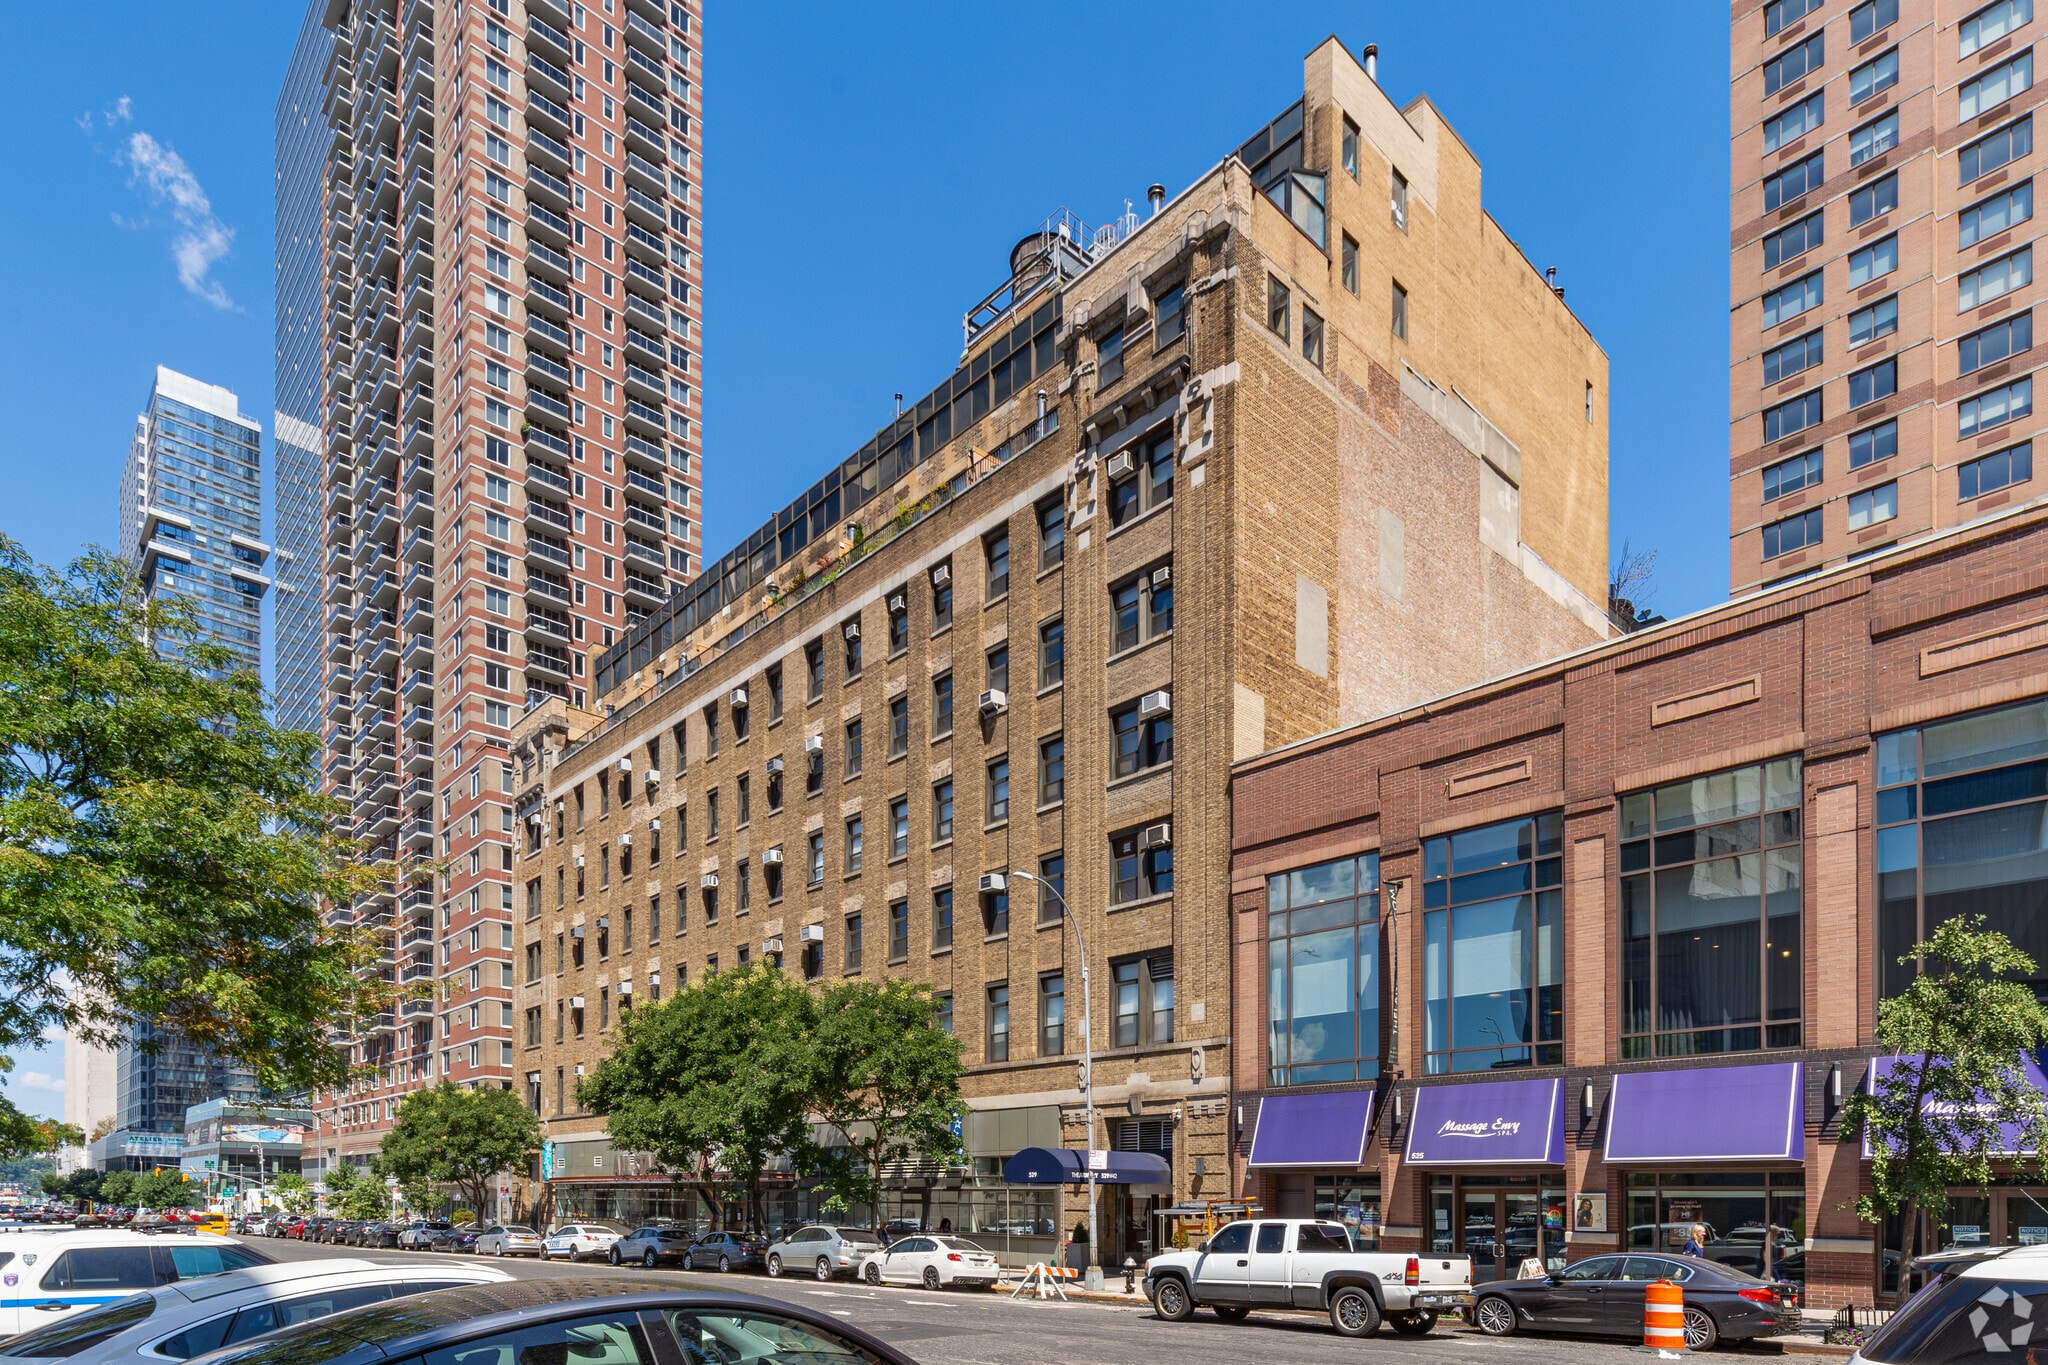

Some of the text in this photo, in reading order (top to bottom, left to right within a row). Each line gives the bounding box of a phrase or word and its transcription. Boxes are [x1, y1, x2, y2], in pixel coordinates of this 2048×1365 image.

[1437, 1117, 1520, 1134] Massage Envy
[1411, 1152, 1424, 1160] 525
